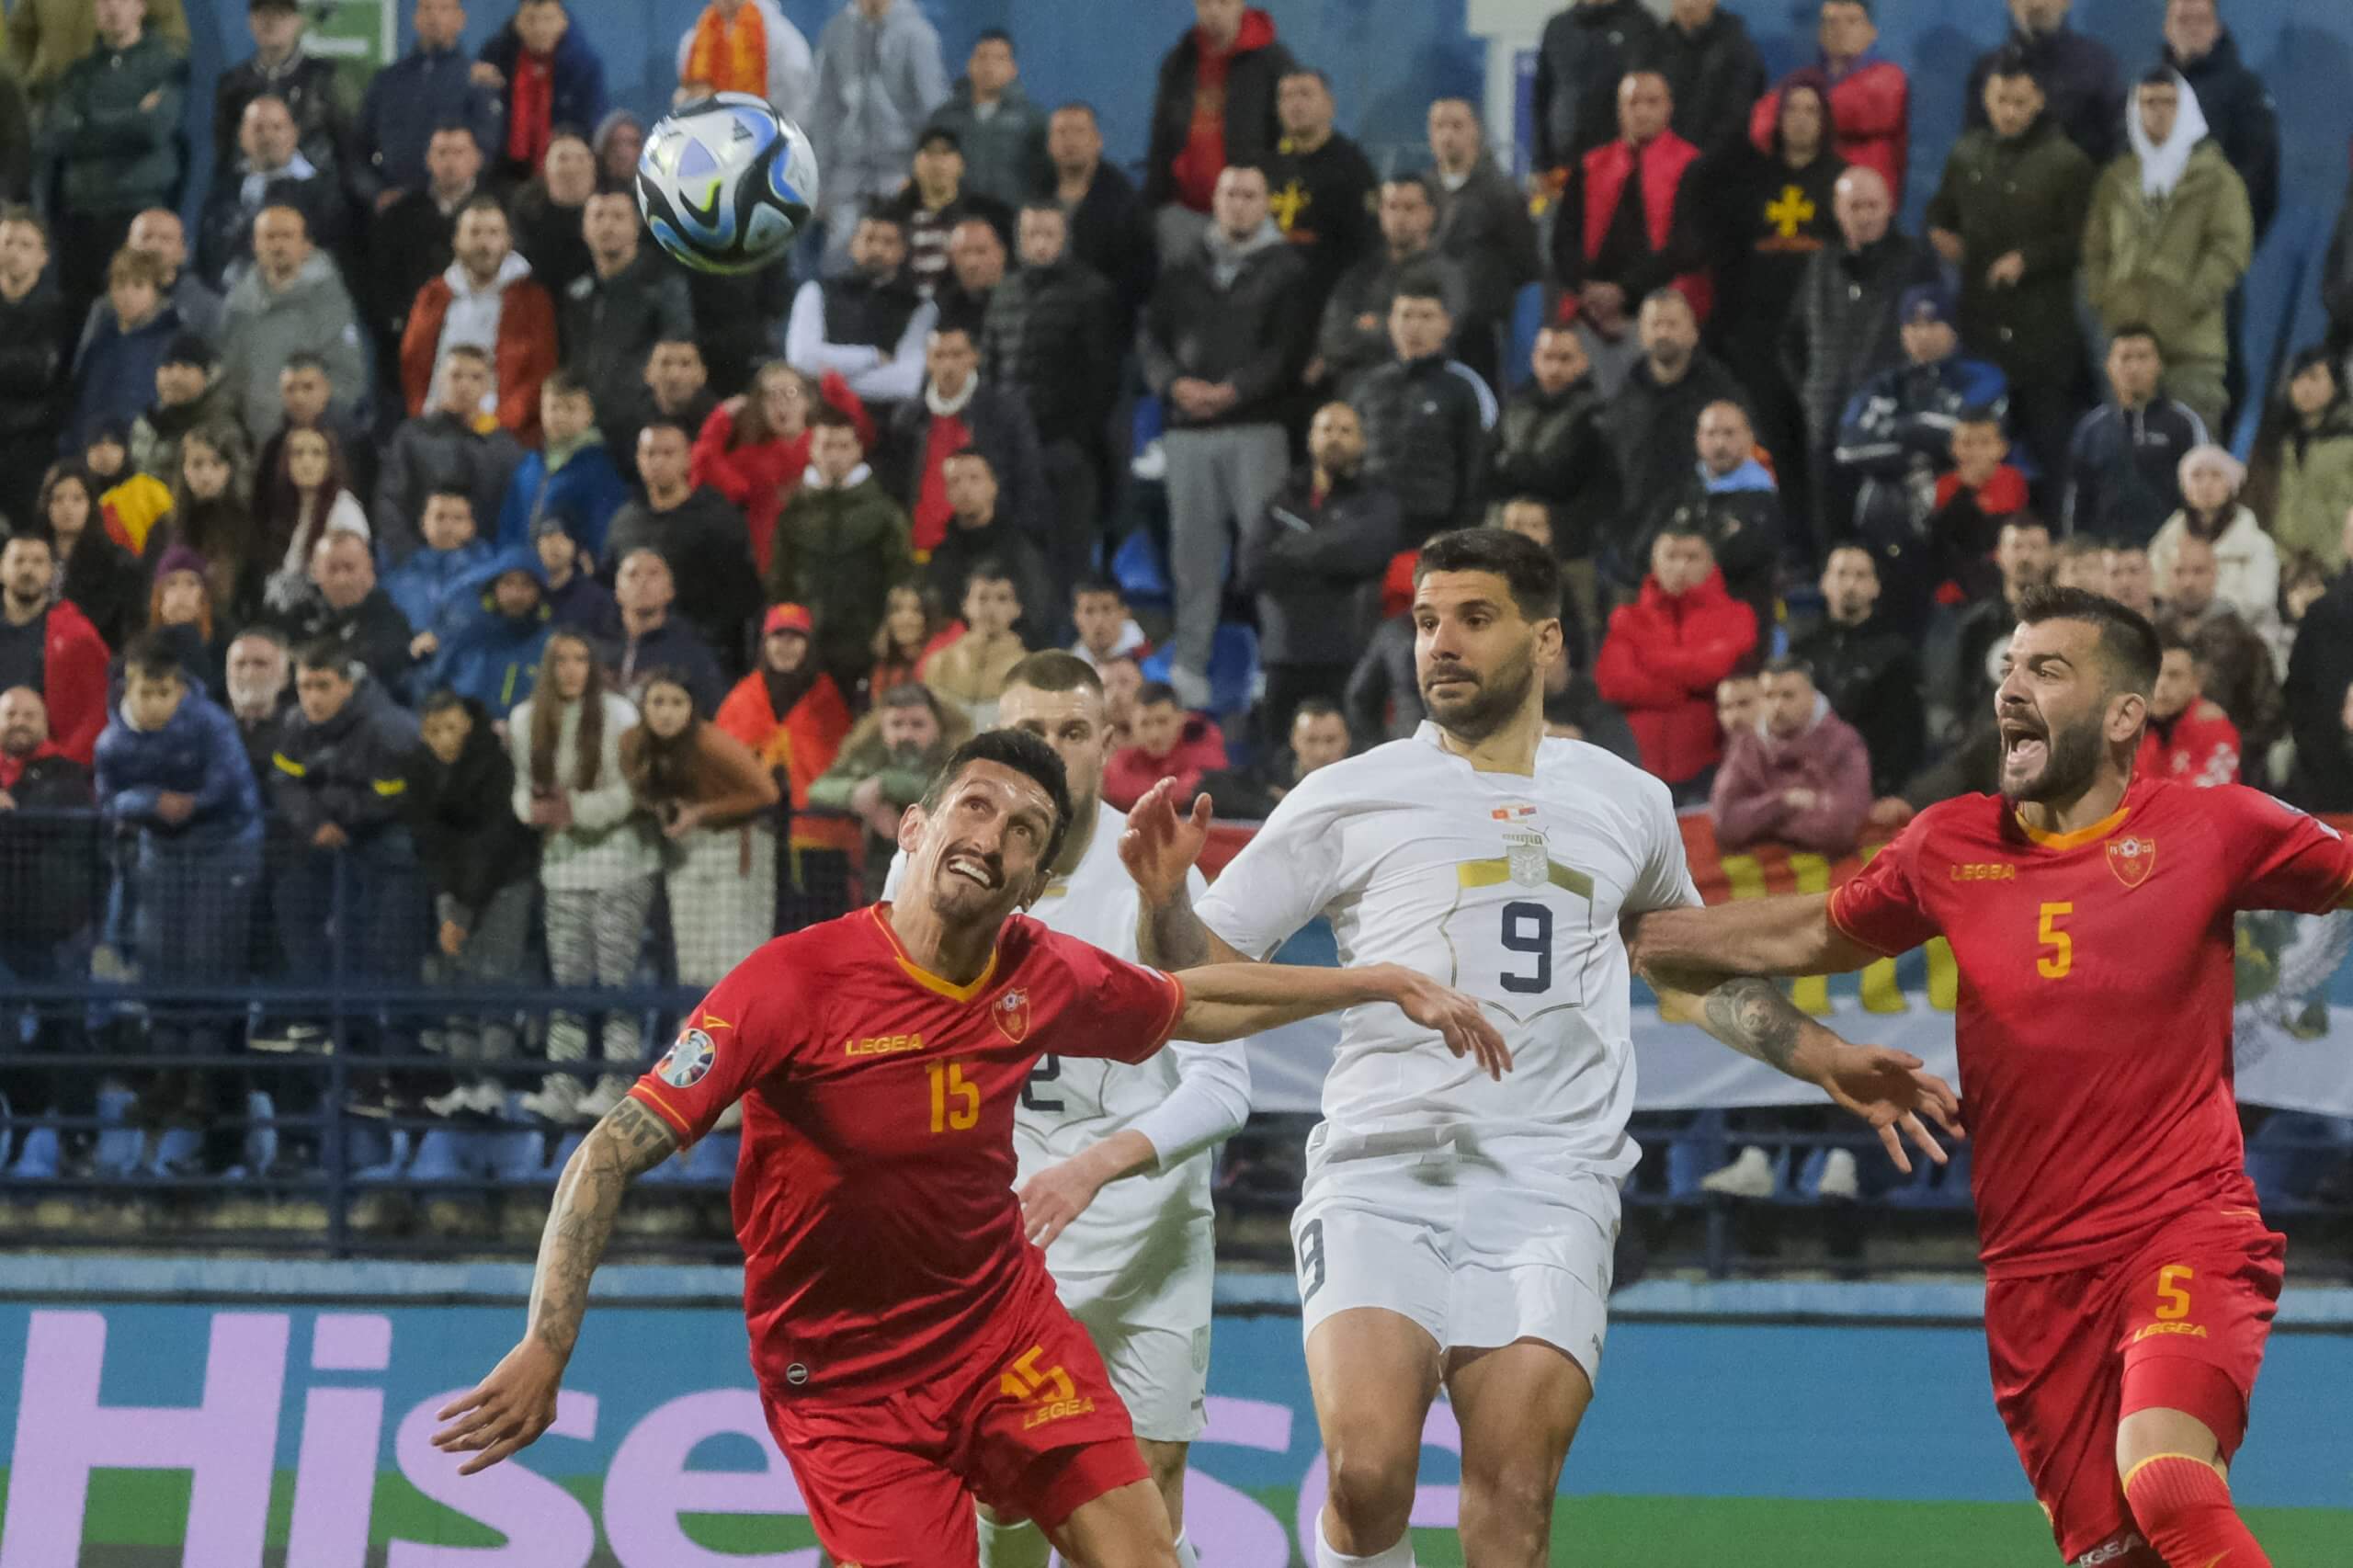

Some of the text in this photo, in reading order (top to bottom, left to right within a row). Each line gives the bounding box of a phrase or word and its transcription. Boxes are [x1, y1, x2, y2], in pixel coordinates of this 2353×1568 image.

[1950, 863, 2015, 881] LEGEA
[1500, 901, 1552, 994] 9
[2037, 902, 2073, 979] 5
[846, 1033, 924, 1056] LEGEA
[926, 1058, 980, 1132] 15
[1299, 1218, 1325, 1309] 9
[2155, 1265, 2193, 1319] 5
[2132, 1322, 2207, 1343] LEGEA
[1000, 1345, 1075, 1403] 15
[1023, 1397, 1095, 1430] LEGEA
